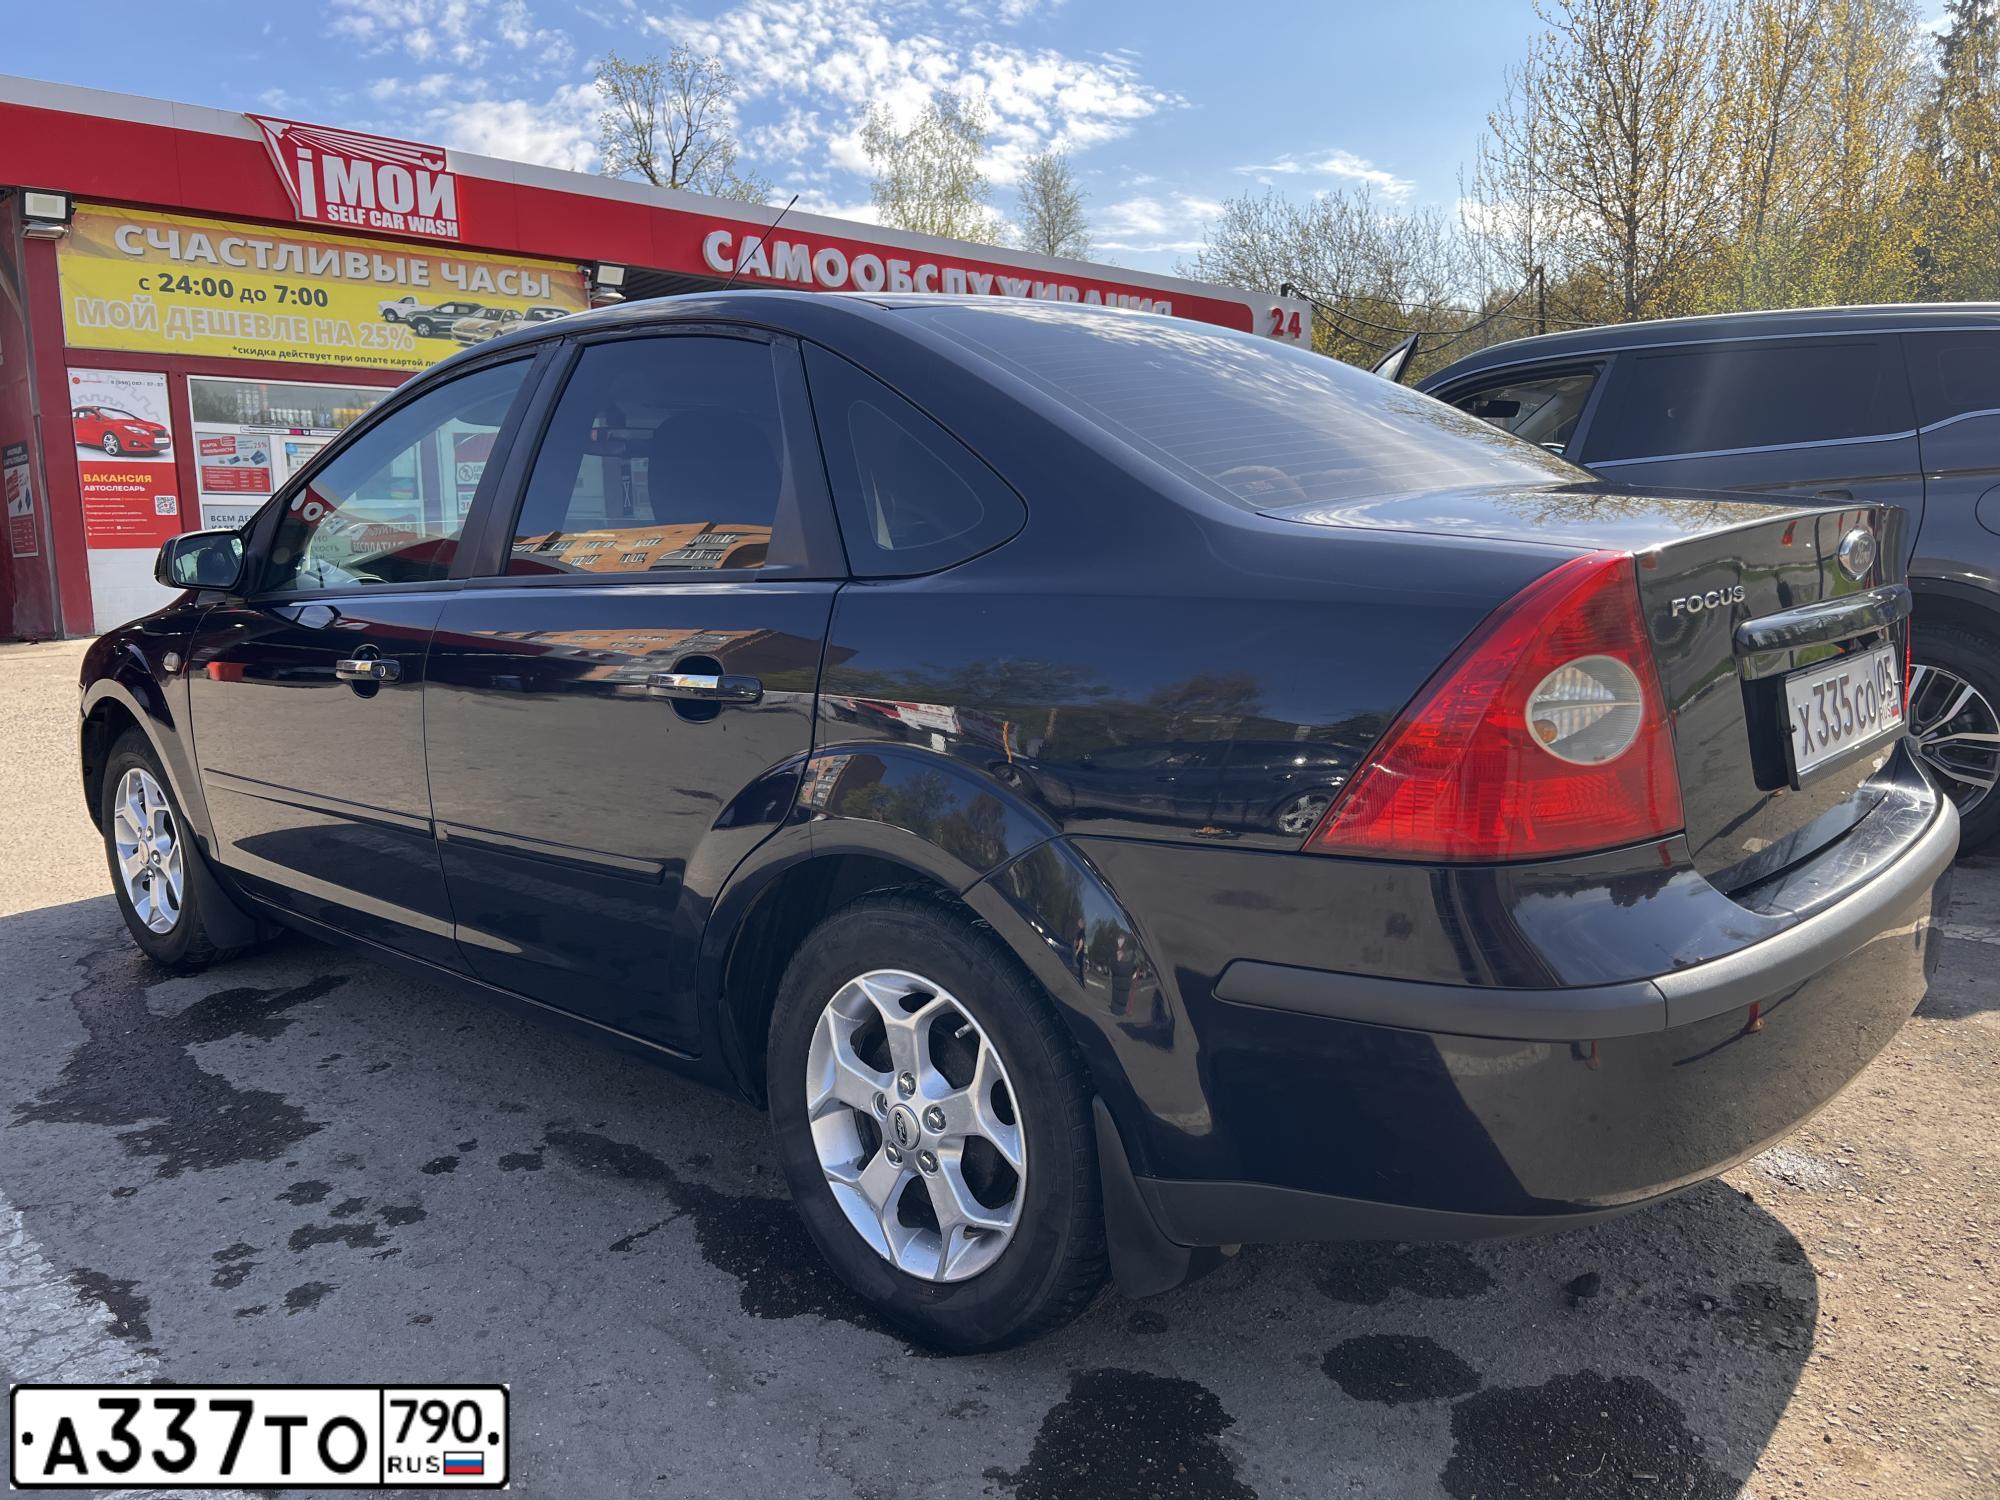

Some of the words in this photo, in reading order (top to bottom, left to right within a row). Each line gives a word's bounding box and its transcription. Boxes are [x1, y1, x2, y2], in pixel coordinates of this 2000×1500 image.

[327, 204, 366, 225] SELF
[369, 210, 405, 230] CAR
[408, 215, 458, 238] WASH
[114, 224, 430, 287] СЧАСТЛИВЫЕ
[441, 261, 550, 298] ЧАСЫ
[138, 277, 150, 291] с
[157, 272, 234, 299] 24:00
[239, 288, 267, 305] до
[273, 284, 328, 307] 7:00
[76, 294, 159, 332] МОЙ
[164, 304, 309, 343] ДЕШЕВЛЕ
[314, 318, 355, 347] НА
[358, 321, 416, 351] 25%
[1269, 306, 1302, 339] 24
[279, 349, 332, 361] действует
[334, 354, 353, 363] при
[355, 355, 388, 364] оплате
[390, 357, 427, 367] картой
[83, 473, 152, 483] ВАКАНСИЯ
[1671, 585, 1746, 617] FOCUS
[1877, 655, 1894, 700] 05
